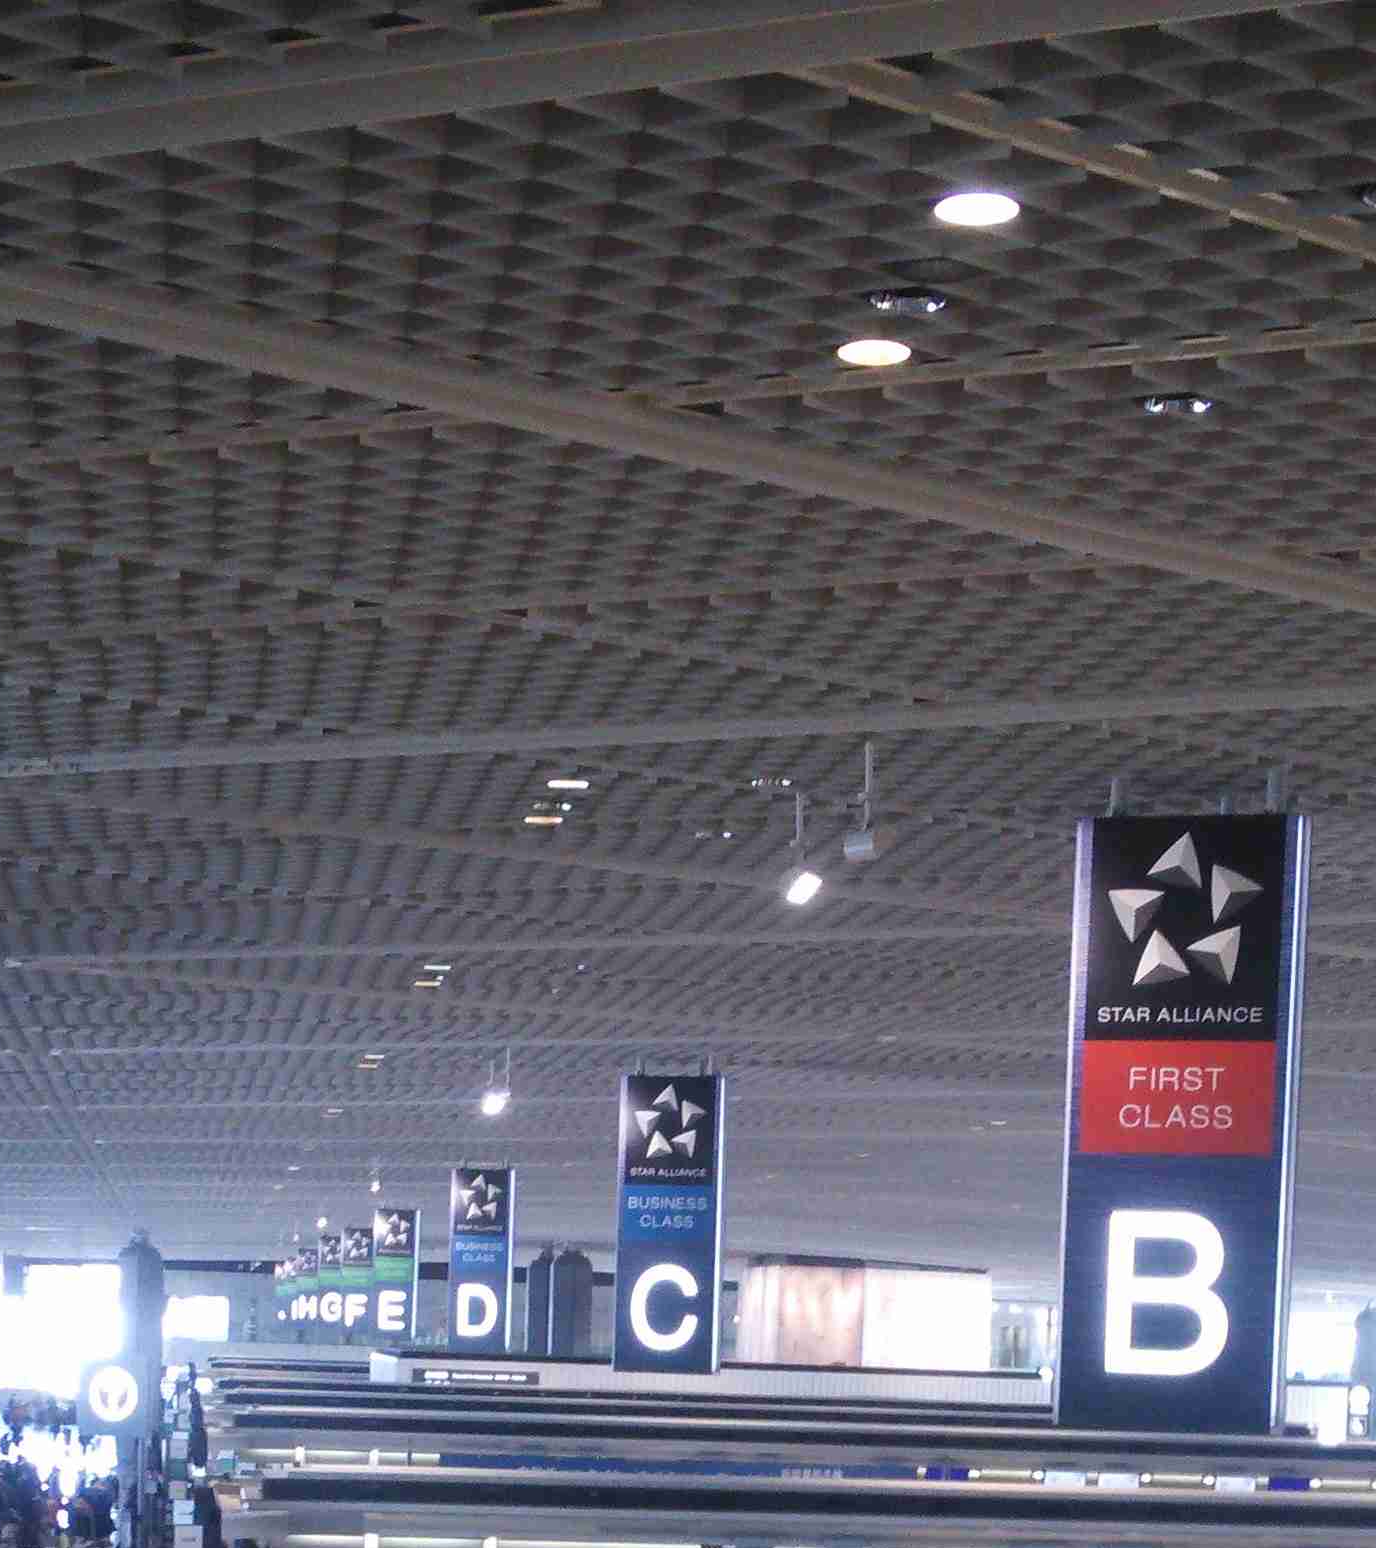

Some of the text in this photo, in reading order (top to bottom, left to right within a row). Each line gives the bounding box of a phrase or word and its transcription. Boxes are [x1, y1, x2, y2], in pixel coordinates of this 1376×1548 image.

[1097, 1006, 1264, 1023] STAR ALLIANCE
[1128, 1066, 1226, 1092] FIRST
[1118, 1103, 1233, 1130] CLASS
[629, 1166, 707, 1178] STAR ALLIANCE
[627, 1195, 707, 1211] BUSINESS
[639, 1214, 695, 1229] CLASS
[1104, 1208, 1230, 1377] B
[344, 1293, 369, 1327] F
[377, 1289, 408, 1331] E
[456, 1282, 498, 1337] D
[629, 1262, 699, 1352] C
